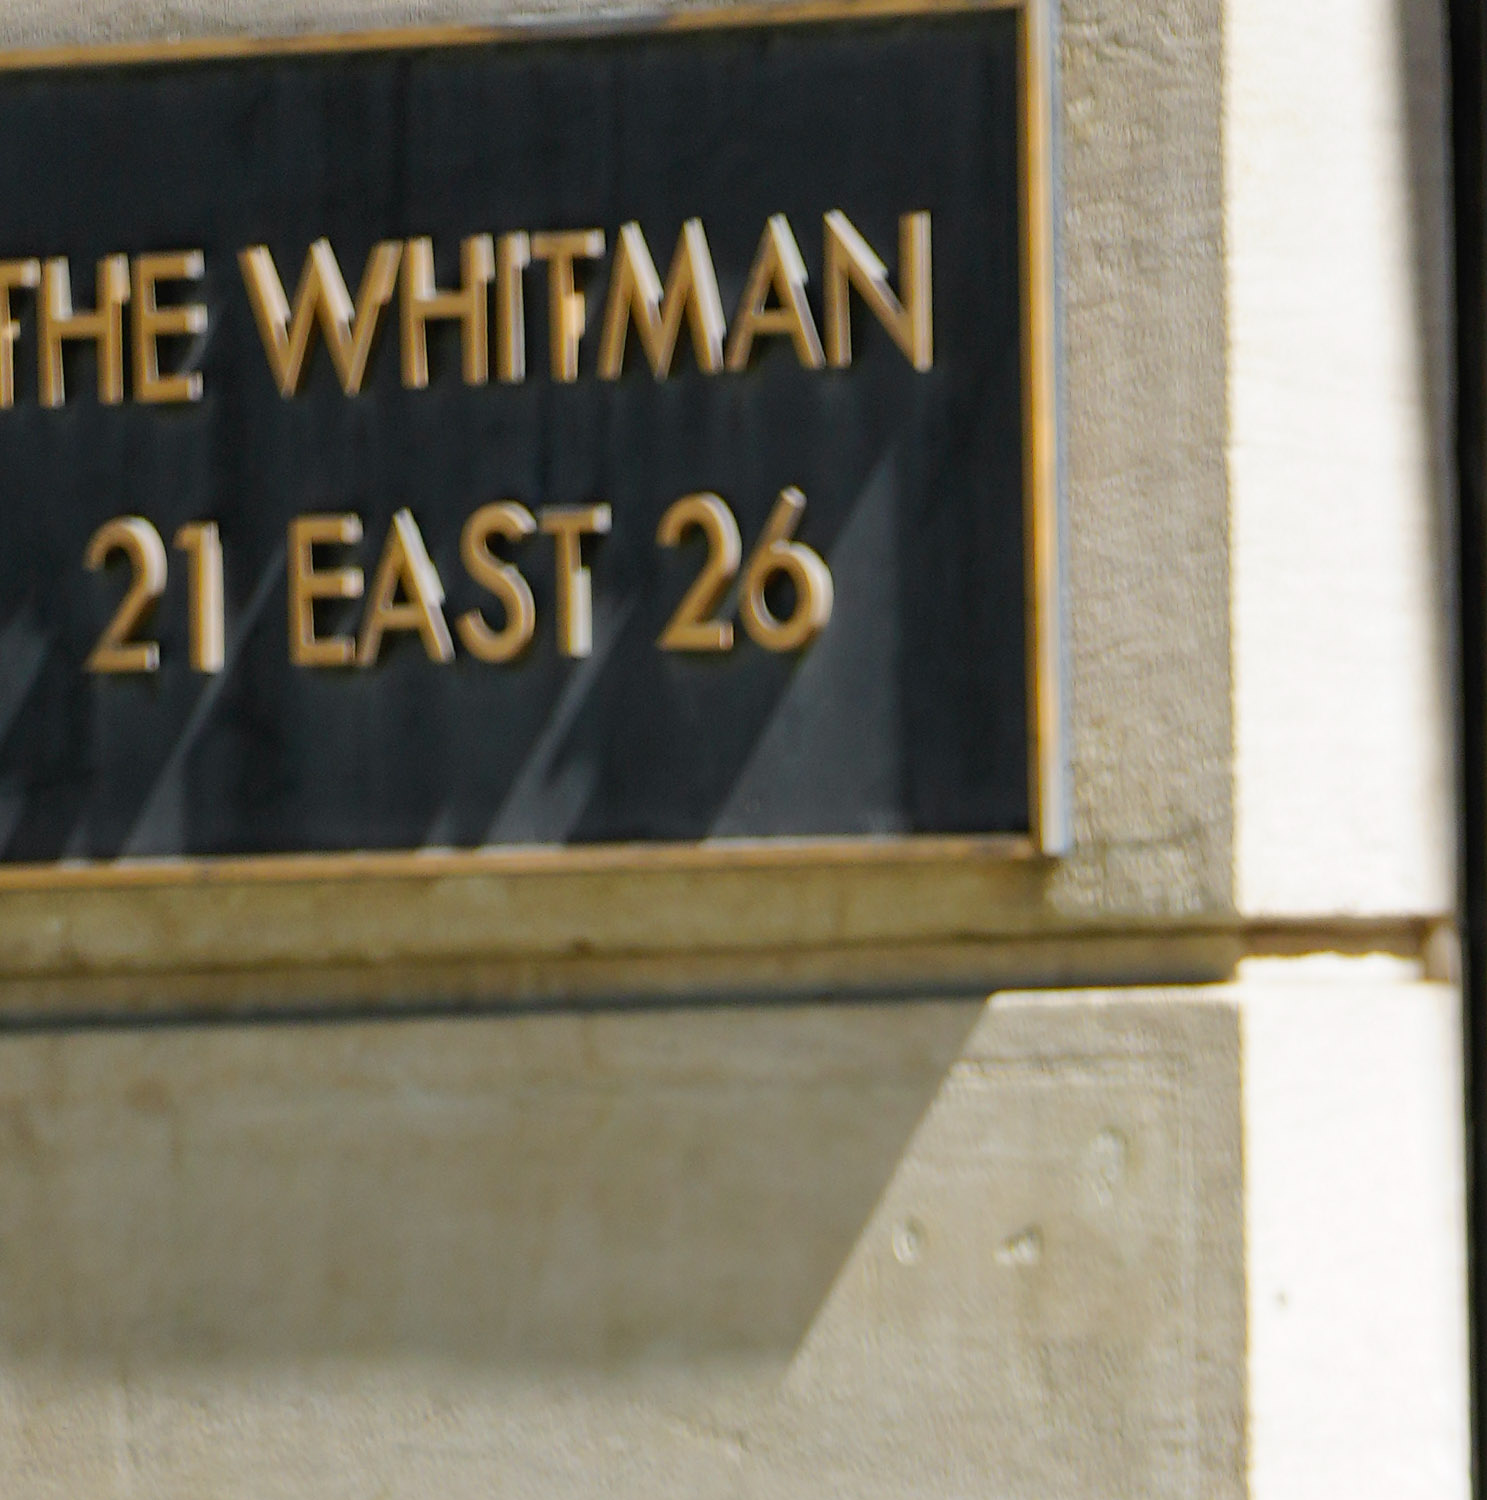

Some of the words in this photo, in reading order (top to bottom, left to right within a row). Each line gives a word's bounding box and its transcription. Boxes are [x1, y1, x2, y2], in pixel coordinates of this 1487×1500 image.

[237, 208, 933, 398] WHITMAN
[84, 514, 226, 674] 21
[287, 502, 613, 668] EAST
[655, 485, 835, 653] 26
